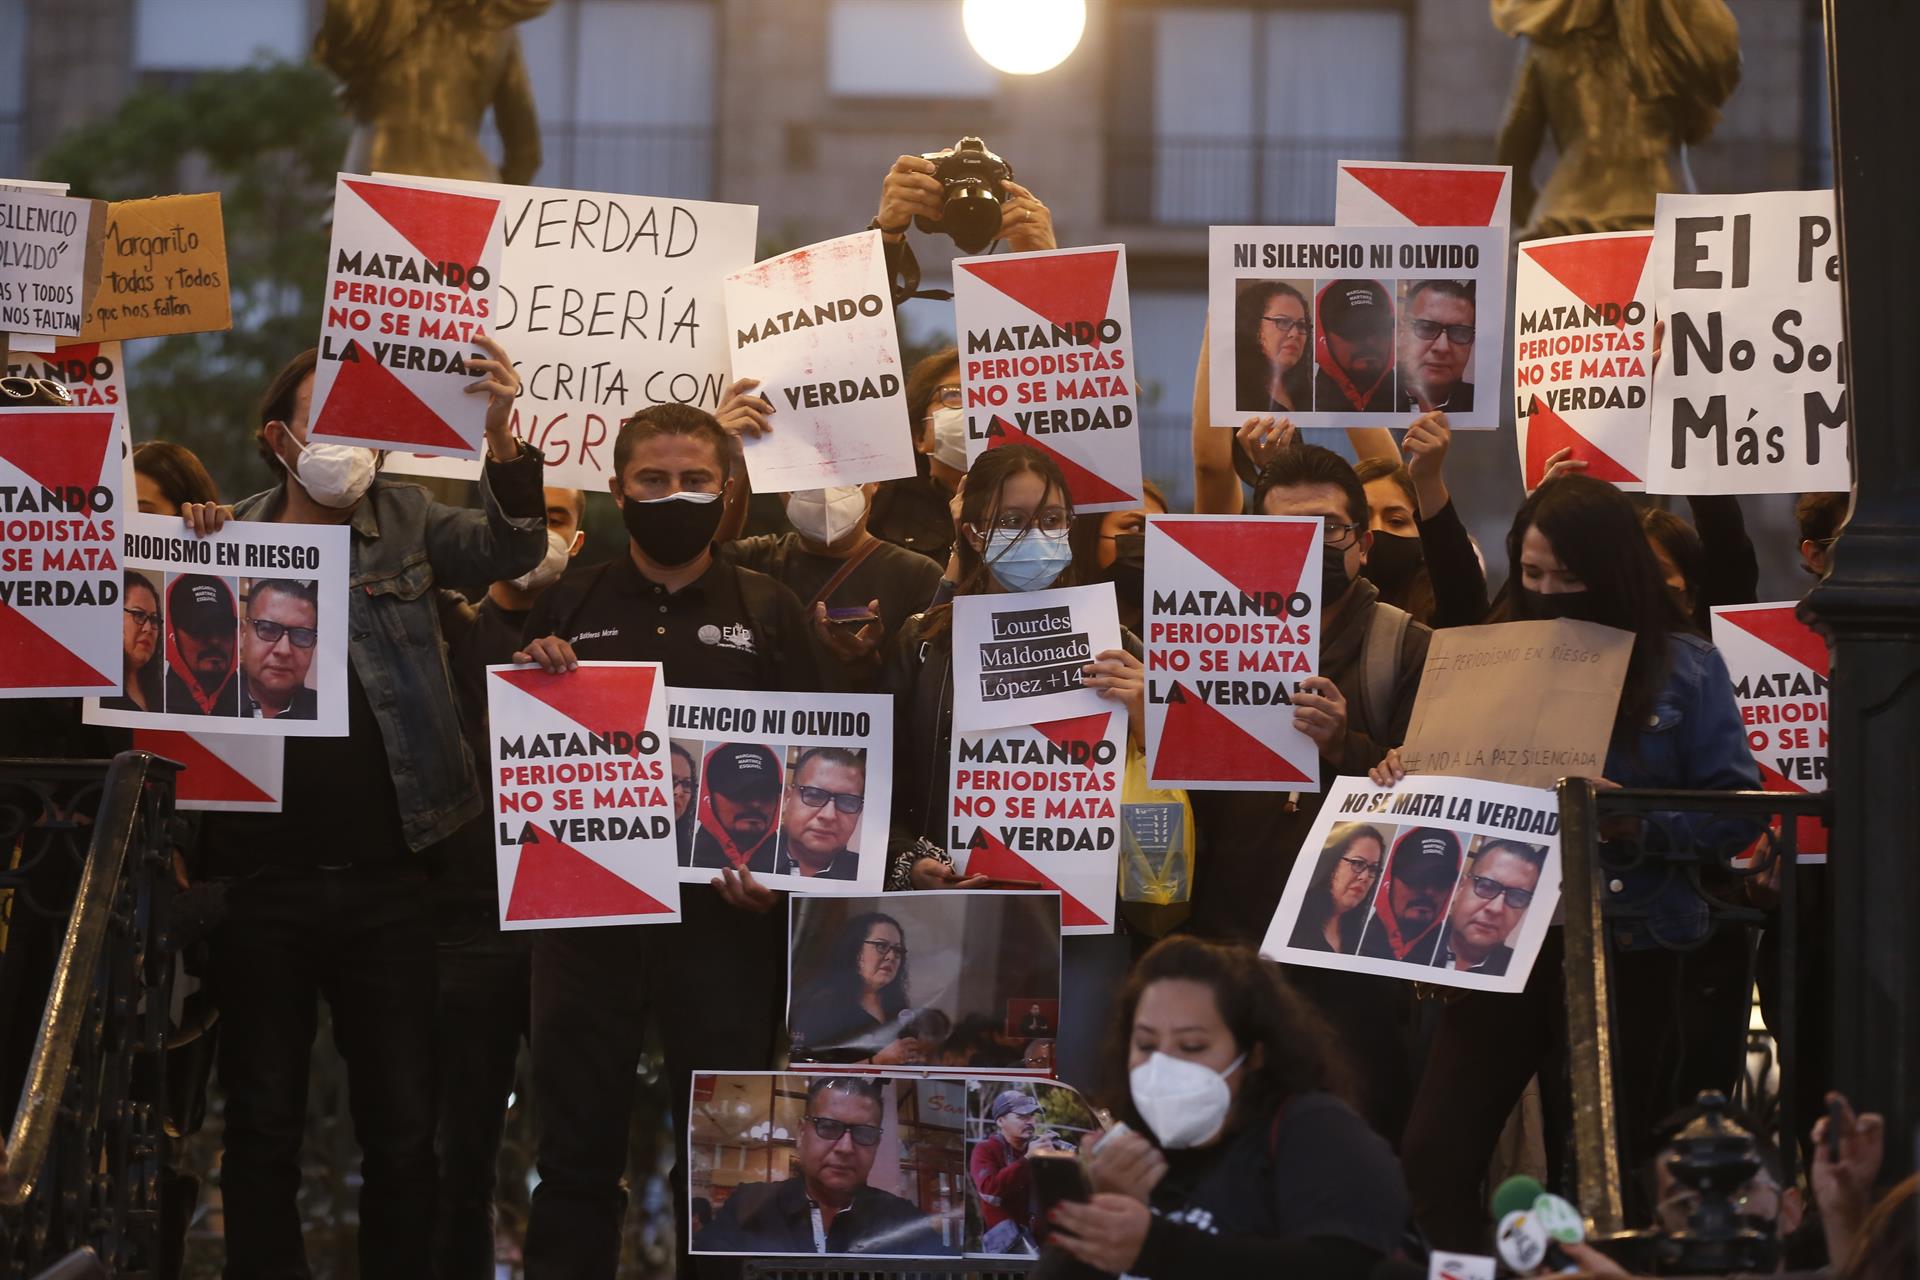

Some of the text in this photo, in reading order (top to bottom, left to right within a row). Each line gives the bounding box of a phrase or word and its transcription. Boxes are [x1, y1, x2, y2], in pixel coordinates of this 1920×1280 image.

[503, 198, 698, 258] VERDAD
[106, 220, 199, 272] Margarito
[1233, 243, 1480, 270] NI SILENCIO NI OLVIDO
[1673, 213, 1751, 290] El
[106, 269, 154, 294] todas
[336, 248, 491, 291] MATANDO
[18, 282, 28, 303] Y
[32, 283, 74, 304] TODOS
[122, 303, 149, 318] nos
[153, 294, 191, 316] faltan
[333, 280, 489, 318] PERIODISTAS
[3, 306, 30, 326] NOS
[33, 308, 80, 333] FALTAN
[327, 306, 487, 343] NO SE MATA
[496, 285, 700, 349] DEBERÍA
[737, 294, 883, 349] MATANDO
[1520, 301, 1646, 336] MATANDO
[967, 318, 1122, 355] MATANDO
[1519, 331, 1646, 362] PERIODISTAS
[1671, 311, 1756, 376] No
[321, 336, 488, 377] LA VERDAD
[968, 349, 1125, 381] PERIODISTAS
[1517, 356, 1646, 388] NO SE MATA
[67, 385, 119, 406] TAS
[645, 371, 724, 408] CON
[784, 373, 900, 411] VERDAD
[968, 375, 1129, 409] NO SE MATA
[1517, 385, 1646, 419] LA VERDAD
[968, 404, 1133, 440] LA VERDAD
[1671, 394, 1785, 470] Más
[2, 547, 118, 572] SE MATA
[217, 542, 240, 567] EN
[245, 544, 320, 570] RIESGO
[0, 580, 119, 607] VERDAD
[1152, 590, 1312, 618] MATANDO
[992, 613, 1071, 636] Lourdes
[1151, 623, 1311, 645] PERIODISTAS
[980, 640, 1090, 667] Maldonado
[1148, 649, 1312, 673] NO SE MATA
[1524, 647, 1544, 661] EN
[1551, 643, 1601, 663] RIESGO
[981, 667, 1091, 699] López +14
[1148, 680, 1186, 704] LA
[762, 709, 786, 734] NI
[791, 710, 871, 737] OLVIDO
[500, 730, 661, 760] MATANDO
[958, 738, 1117, 765] MATANDO
[1778, 728, 1809, 750] SE
[1465, 750, 1485, 766] LA
[1492, 749, 1518, 766] PAZ
[1523, 748, 1597, 767] SILENCIADA
[500, 761, 664, 786] PERIODISTAS
[956, 770, 1116, 792] PERIODISTAS
[499, 786, 668, 814] NO SE MATA
[953, 796, 1115, 819] NO SE MATA
[1339, 792, 1561, 836] NO SE MATA LA VERDAD
[500, 815, 671, 846] LA VERDAD
[951, 825, 988, 850] LA
[999, 827, 1115, 851] VERDAD
